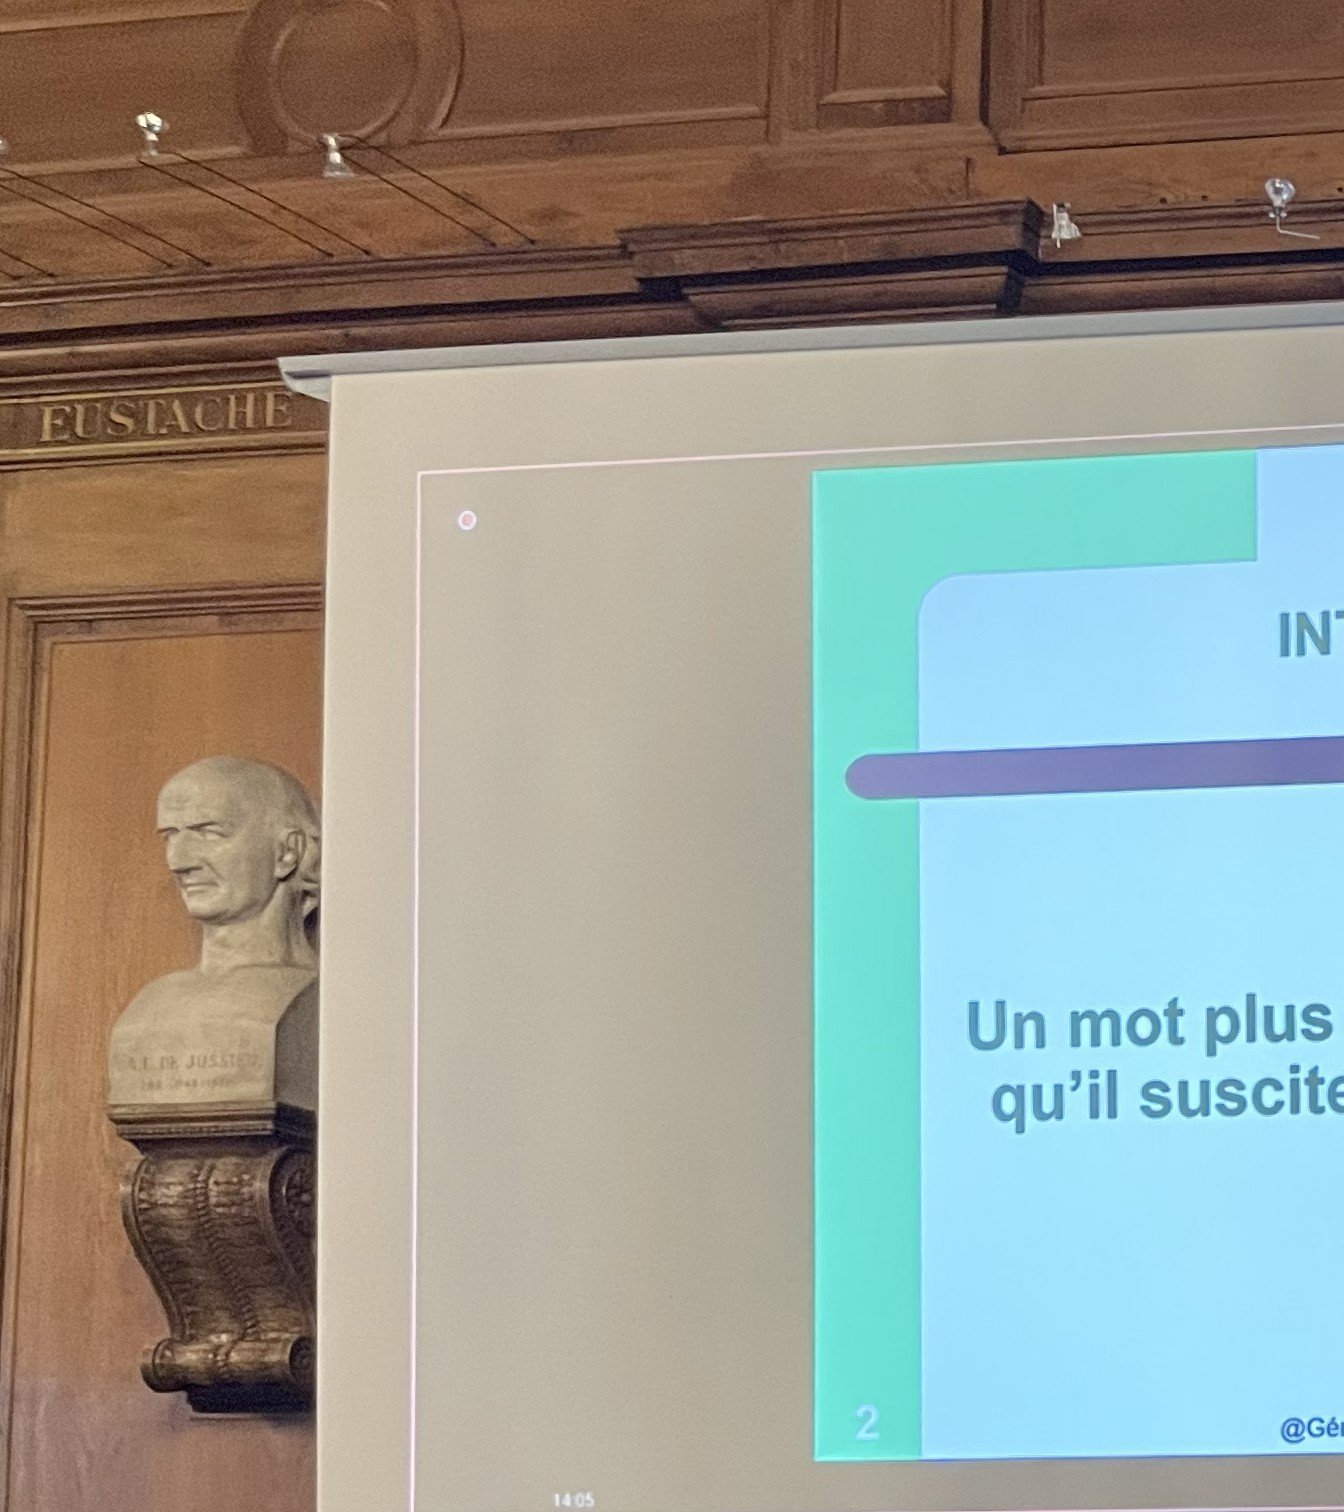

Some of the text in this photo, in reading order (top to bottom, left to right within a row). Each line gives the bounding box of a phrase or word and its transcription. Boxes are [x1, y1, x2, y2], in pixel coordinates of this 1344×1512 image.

[38, 390, 294, 444] EUSTACHE
[969, 999, 1049, 1053] Un
[1071, 997, 1187, 1049] mot
[1206, 992, 1335, 1059] plus
[992, 1064, 1122, 1137] qu’il
[855, 1403, 881, 1441] 2
